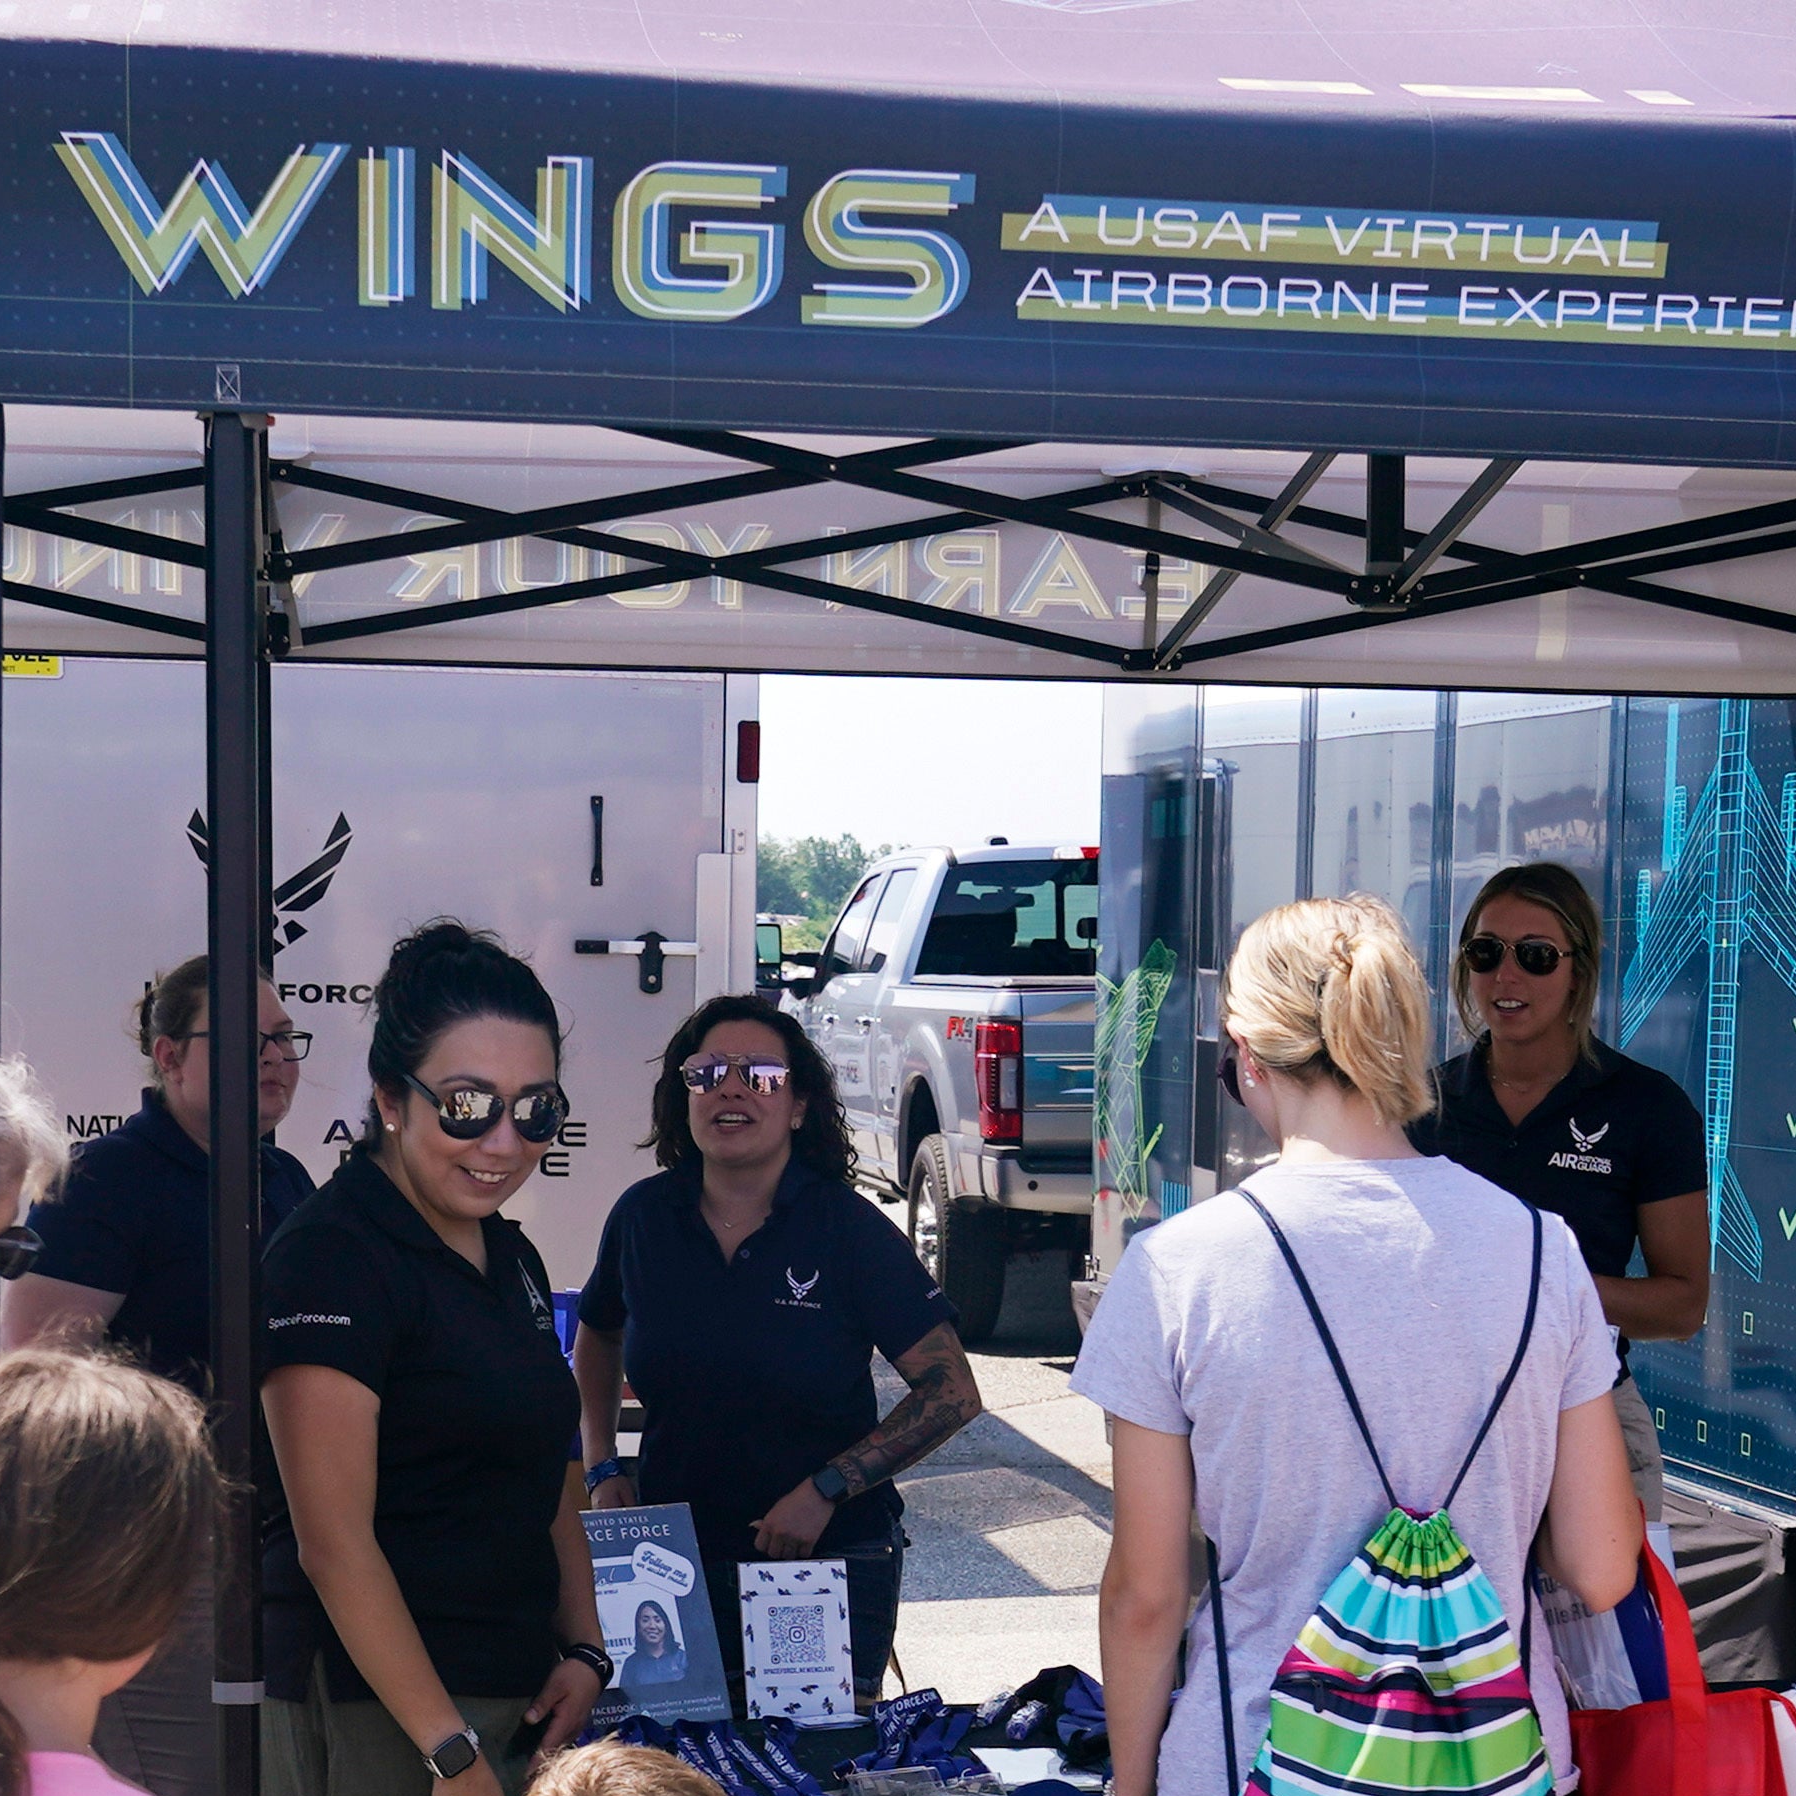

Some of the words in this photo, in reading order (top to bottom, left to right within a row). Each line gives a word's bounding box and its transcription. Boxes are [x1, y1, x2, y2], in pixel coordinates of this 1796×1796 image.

[54, 130, 975, 327] WINGS
[1020, 203, 1070, 243] A
[1098, 205, 1301, 254] USAF
[1326, 216, 1658, 269] VIRTUAL
[1017, 269, 1428, 321] AIRBORNE
[281, 984, 375, 1003] FORC
[1547, 1152, 1578, 1170] AIR
[1577, 1161, 1612, 1175] GUARD
[268, 1312, 351, 1330] SpaceForce.com
[587, 1528, 614, 1542] ACE
[620, 1523, 671, 1539] FORCE
